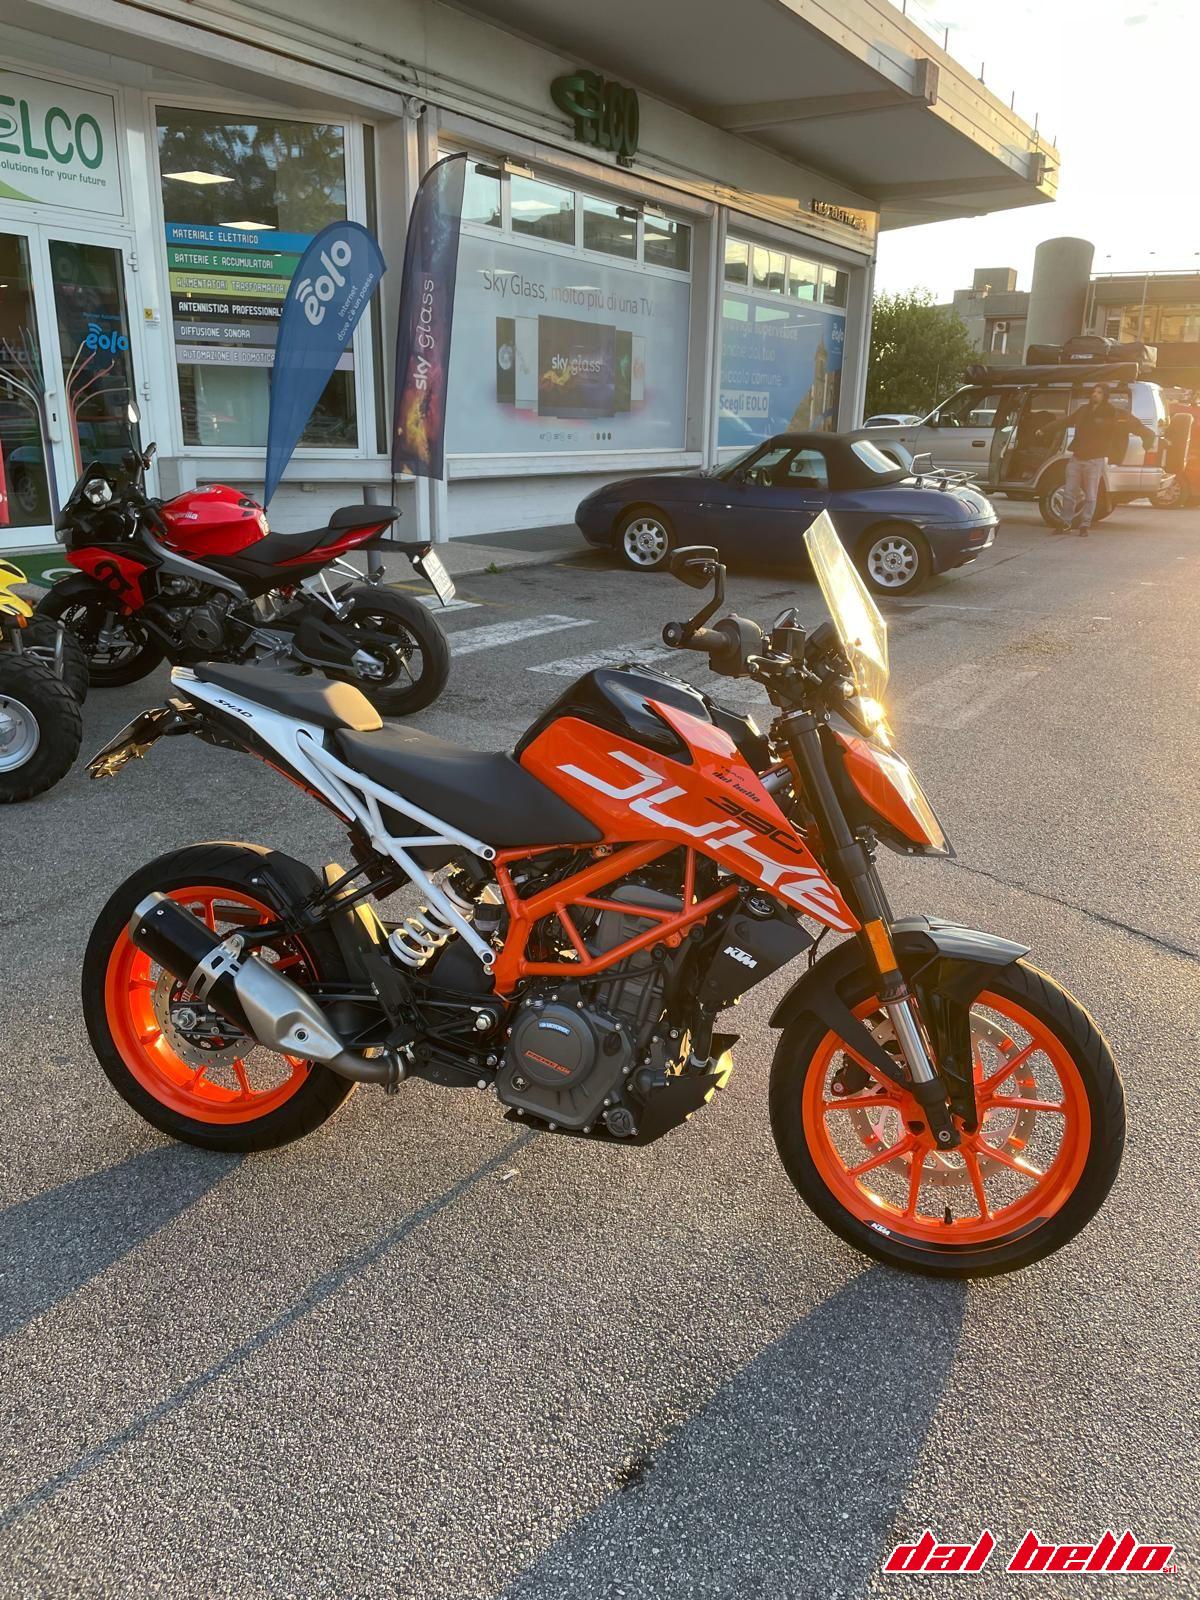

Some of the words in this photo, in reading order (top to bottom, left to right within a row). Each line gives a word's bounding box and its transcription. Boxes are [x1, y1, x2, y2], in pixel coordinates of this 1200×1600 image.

[0, 159, 39, 175] olutions
[41, 166, 55, 177] for
[57, 170, 77, 181] your
[79, 173, 107, 187] future
[172, 228, 215, 241] MATERIALE
[218, 231, 259, 244] ELETTRICO
[174, 252, 209, 265] BATTERIE
[213, 256, 218, 266] E
[221, 256, 273, 269] ACCUMULATORI
[176, 276, 228, 290] ALIMENTATORI
[483, 268, 508, 298] Sky
[510, 274, 548, 303] Glass,
[551, 286, 585, 306] molto
[606, 291, 617, 310] di
[618, 299, 638, 314] una
[178, 301, 229, 314] ANTENNISTICA
[337, 321, 351, 341] dove
[359, 273, 375, 300] paese
[418, 279, 435, 349] glass
[180, 326, 221, 337] DIFFUSIONE
[224, 328, 251, 339] SONORA
[182, 350, 231, 361] AUTOMAZIONE
[234, 352, 238, 361] E
[551, 353, 569, 373] sky
[571, 354, 602, 376] glass
[412, 355, 432, 391] sky
[719, 393, 745, 415] Scegli
[746, 395, 768, 412] EOLO
[213, 698, 254, 718] SHAD
[712, 771, 732, 783] dal
[732, 783, 761, 802] bello
[556, 750, 853, 930] DUKE
[723, 946, 758, 969] KTM
[870, 1222, 891, 1236] KTM
